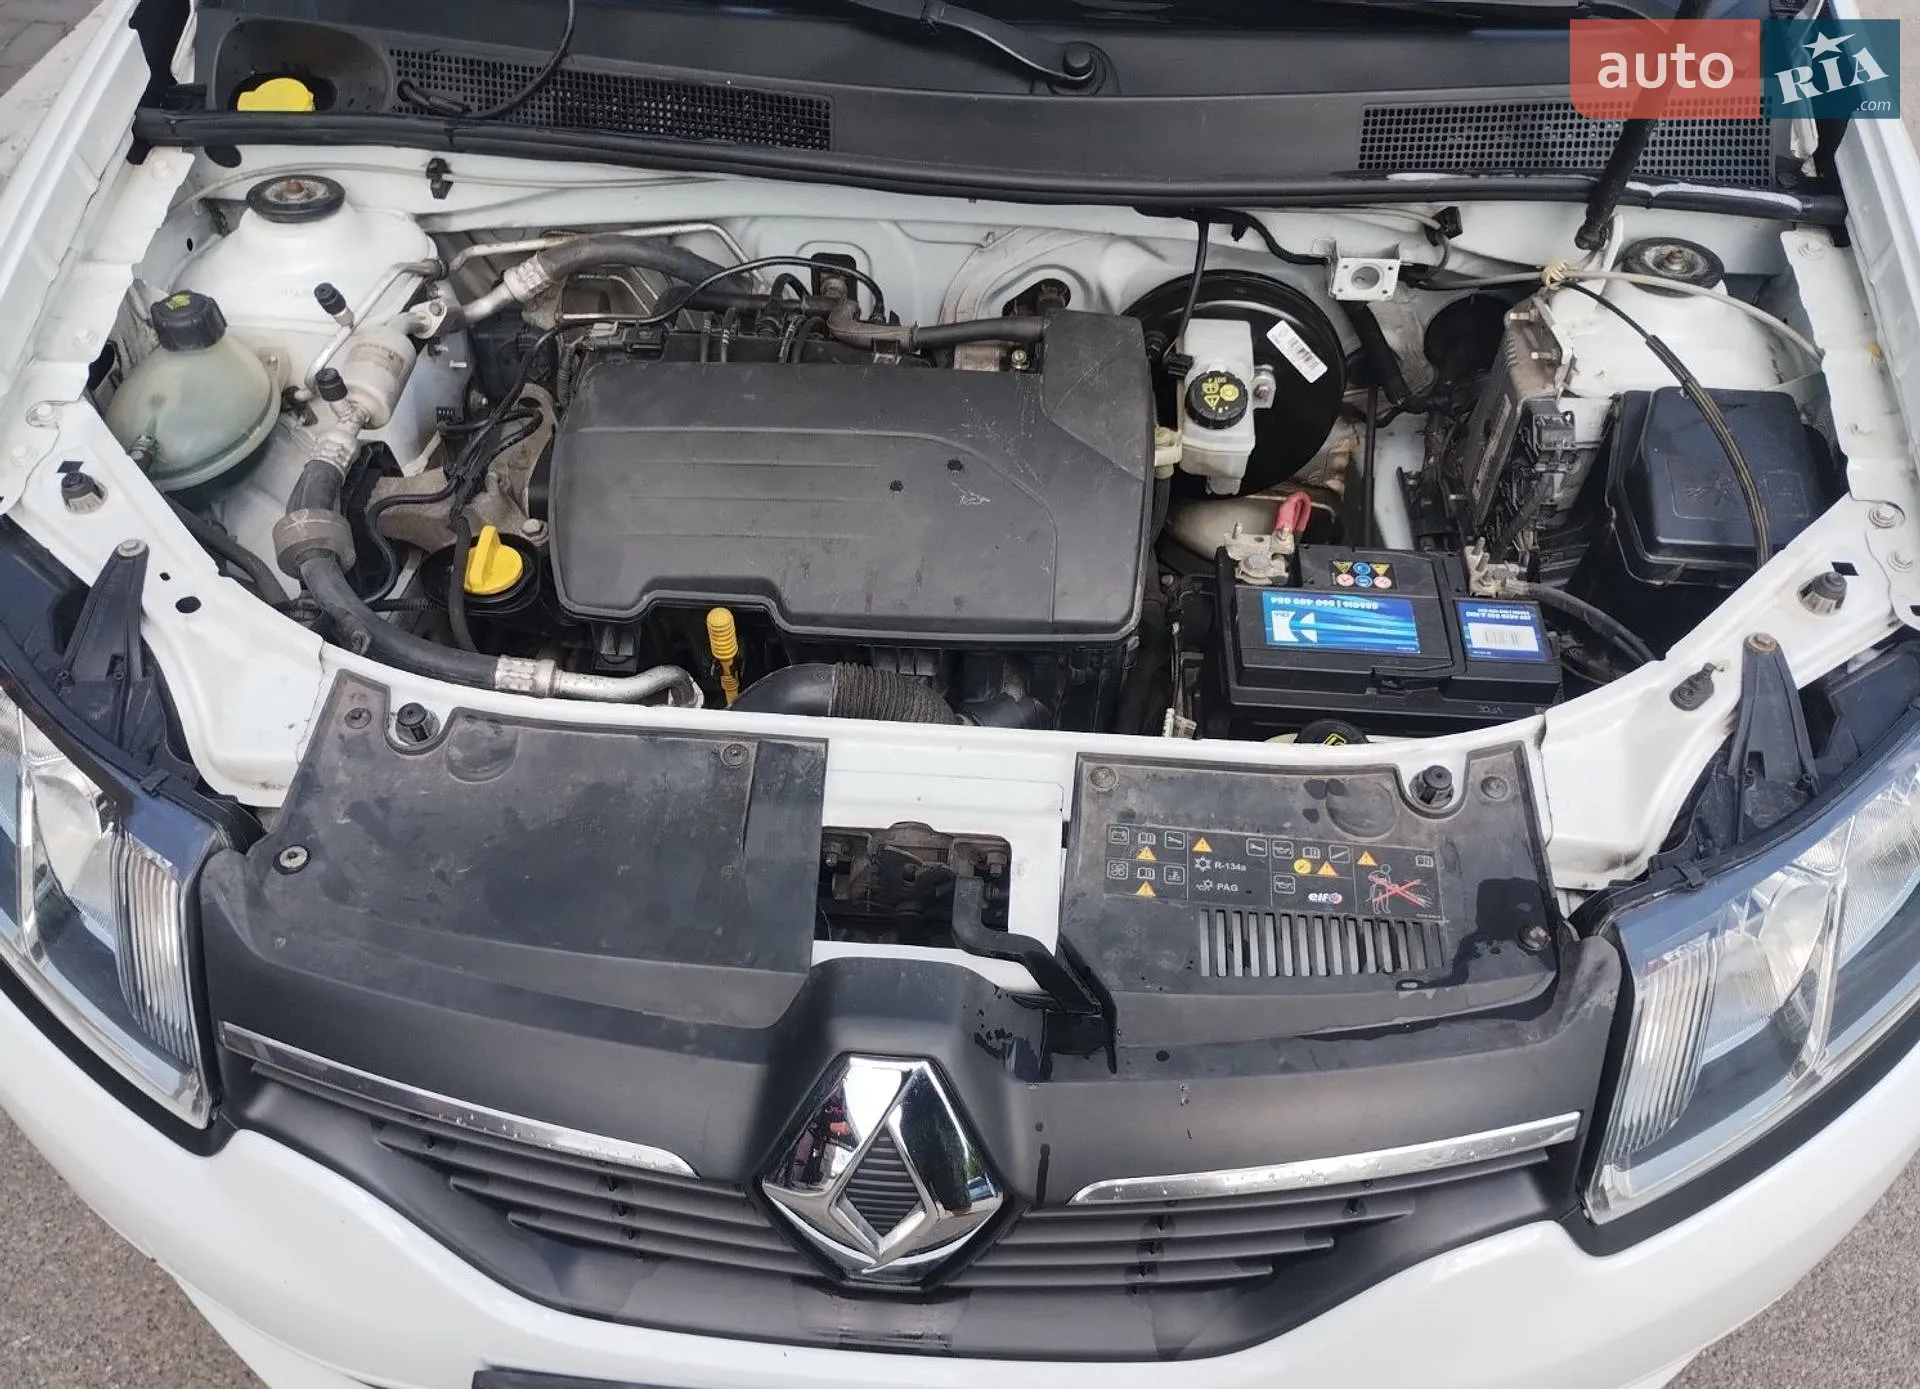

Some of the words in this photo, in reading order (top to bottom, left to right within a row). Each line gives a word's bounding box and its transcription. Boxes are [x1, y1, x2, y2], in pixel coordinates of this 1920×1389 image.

[1214, 861, 1247, 872] R-134a
[1217, 882, 1239, 892] PAG
[1308, 892, 1328, 902] elf
